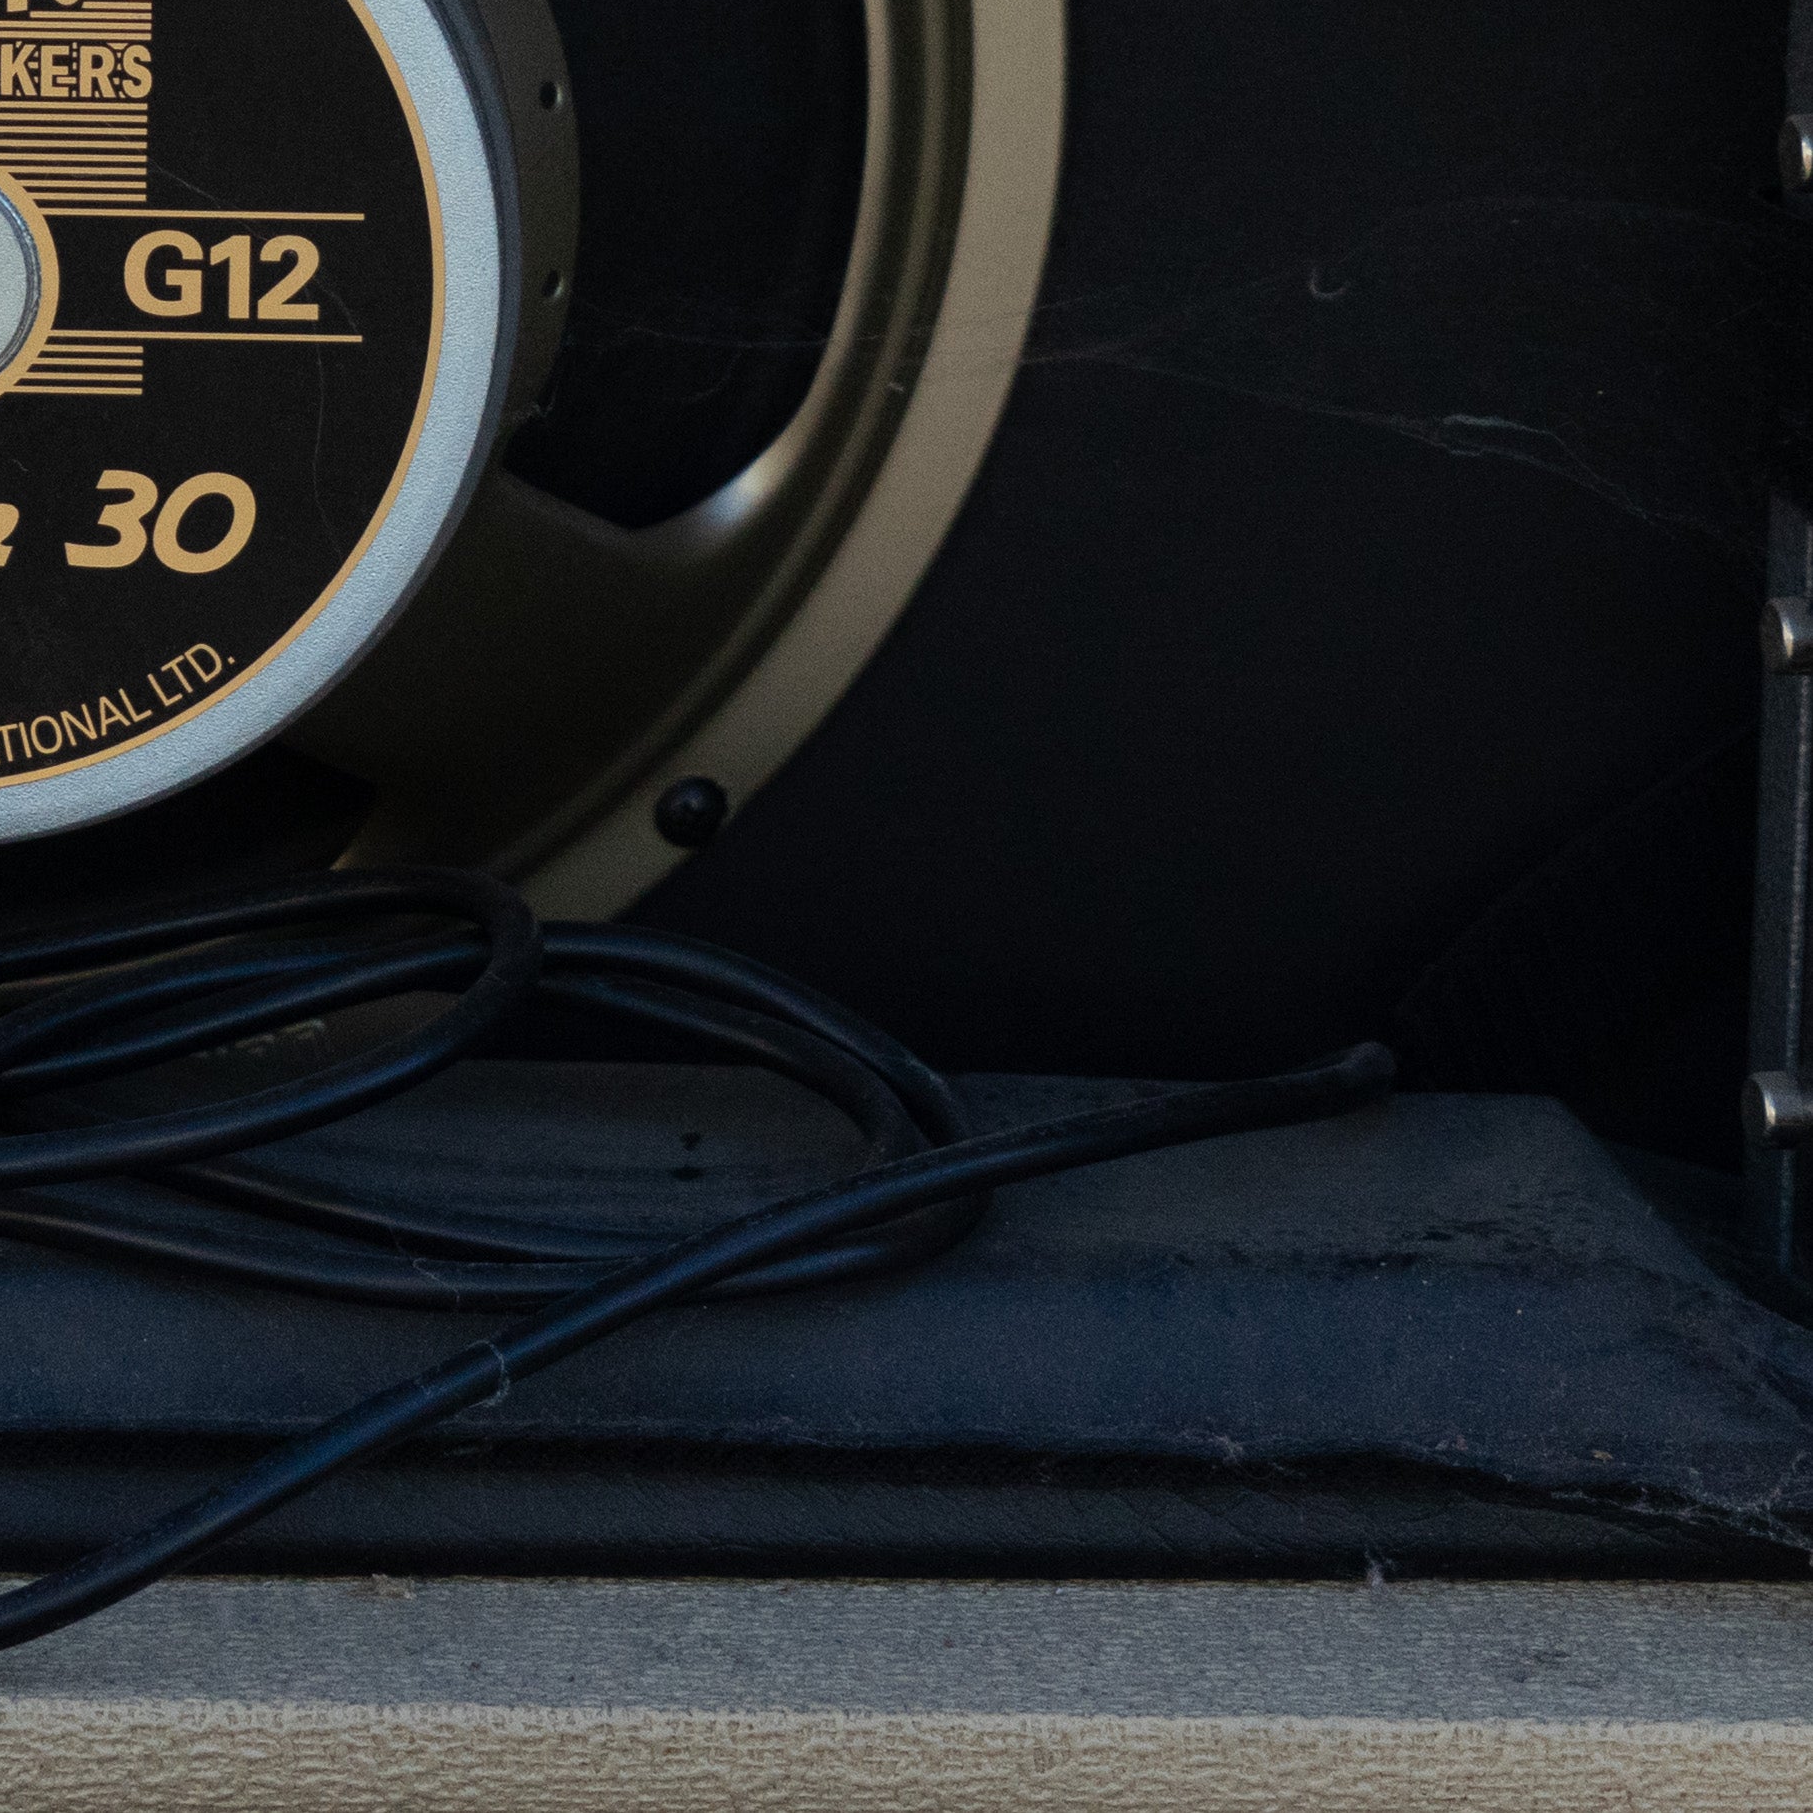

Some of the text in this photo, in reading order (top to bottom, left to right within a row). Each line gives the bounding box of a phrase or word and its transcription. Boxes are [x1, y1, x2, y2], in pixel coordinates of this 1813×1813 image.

[122, 229, 321, 323] G12
[64, 468, 258, 575] 30
[148, 640, 237, 711] LTD.
